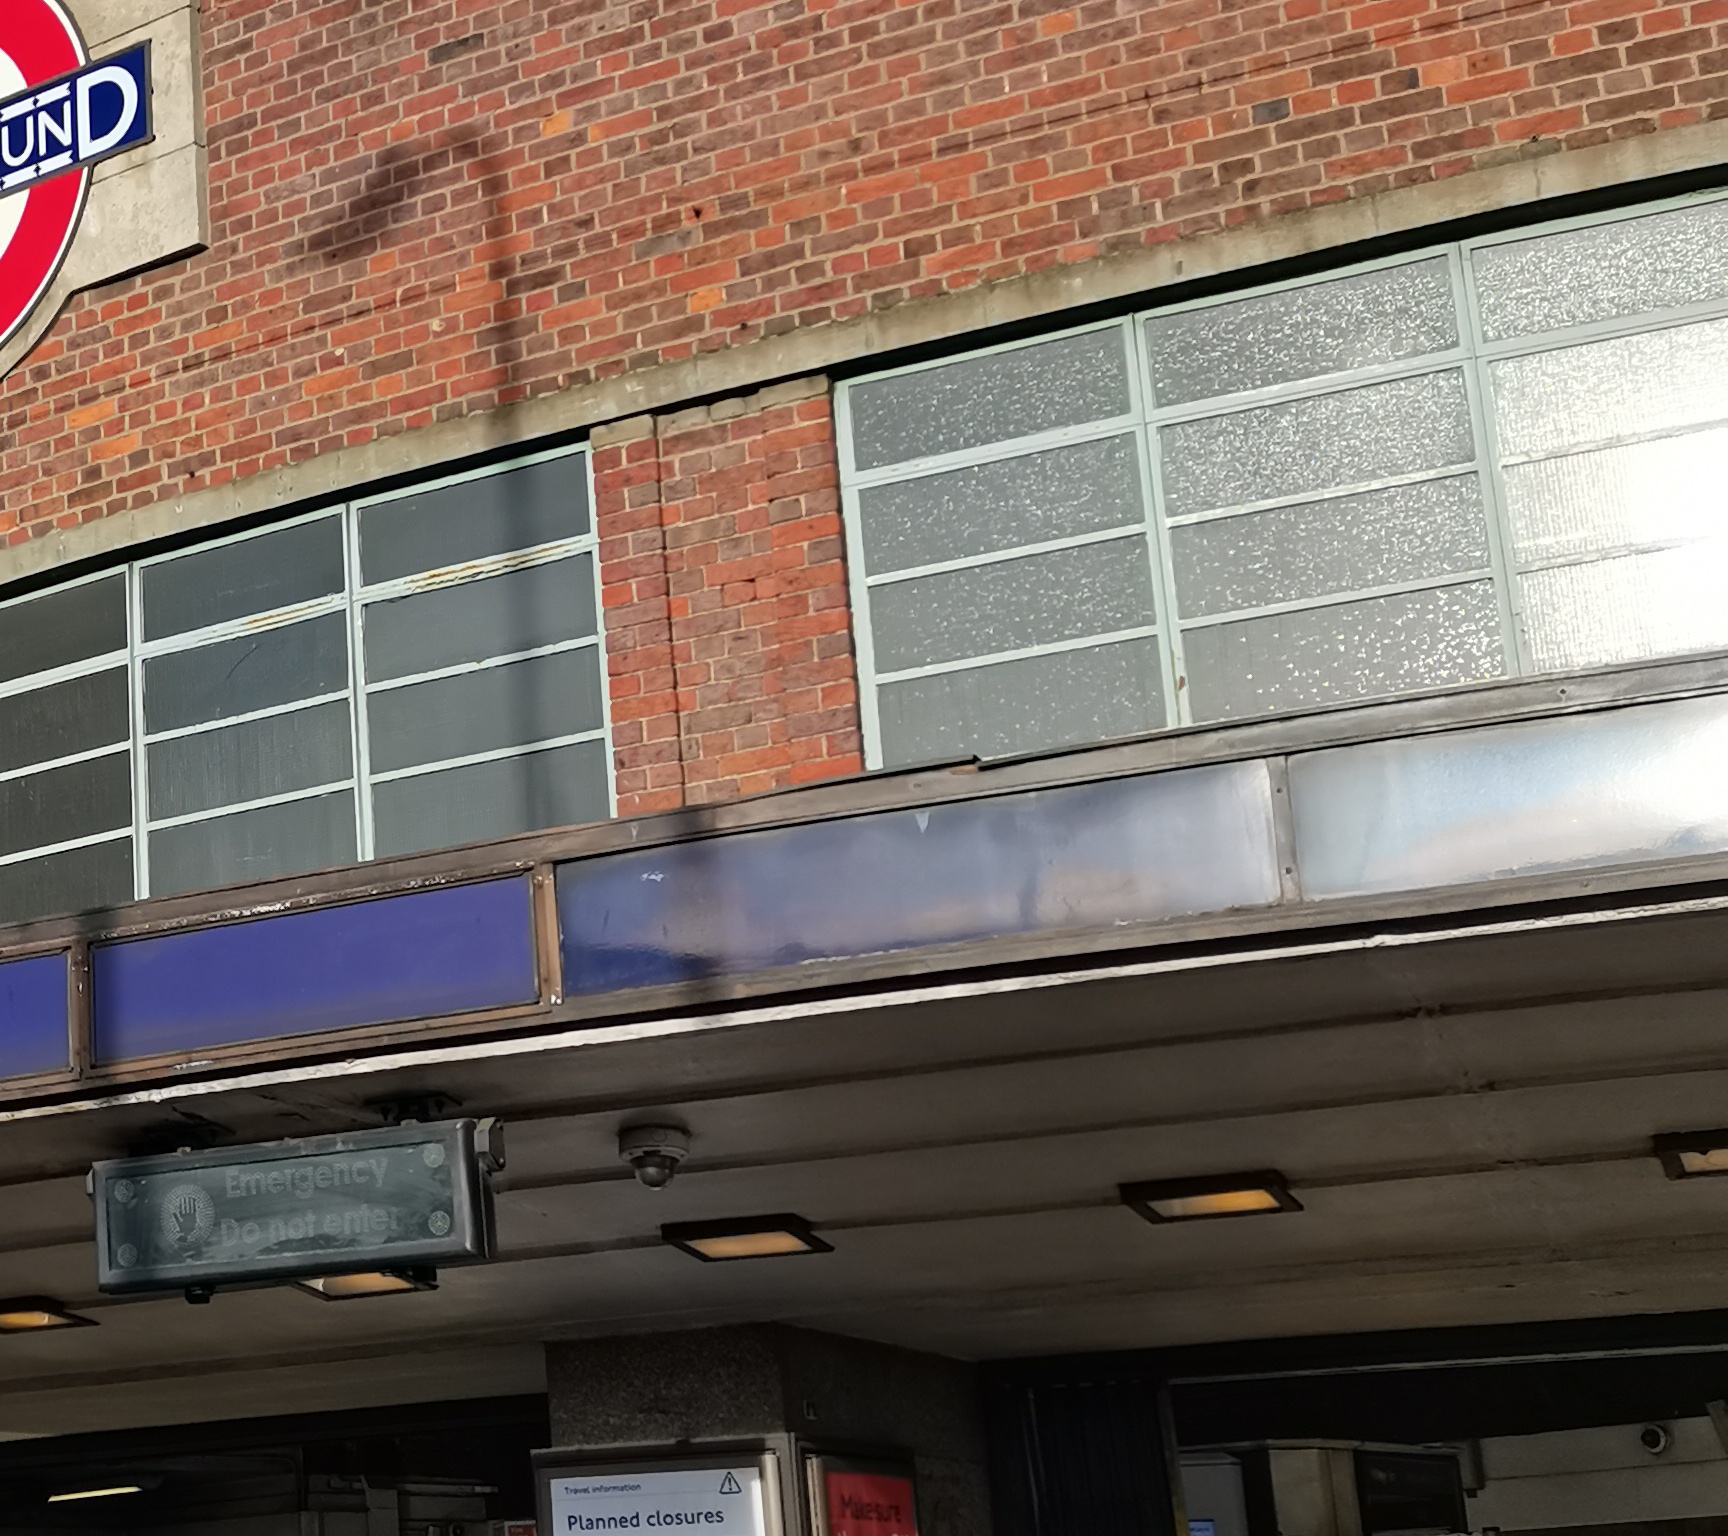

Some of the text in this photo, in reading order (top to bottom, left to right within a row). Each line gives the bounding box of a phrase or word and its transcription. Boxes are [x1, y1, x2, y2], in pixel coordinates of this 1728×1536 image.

[225, 1157, 389, 1199] Emergency
[221, 1203, 400, 1247] Do not enter
[564, 1483, 642, 1495] Travel information
[568, 1509, 725, 1531] Planned closures
